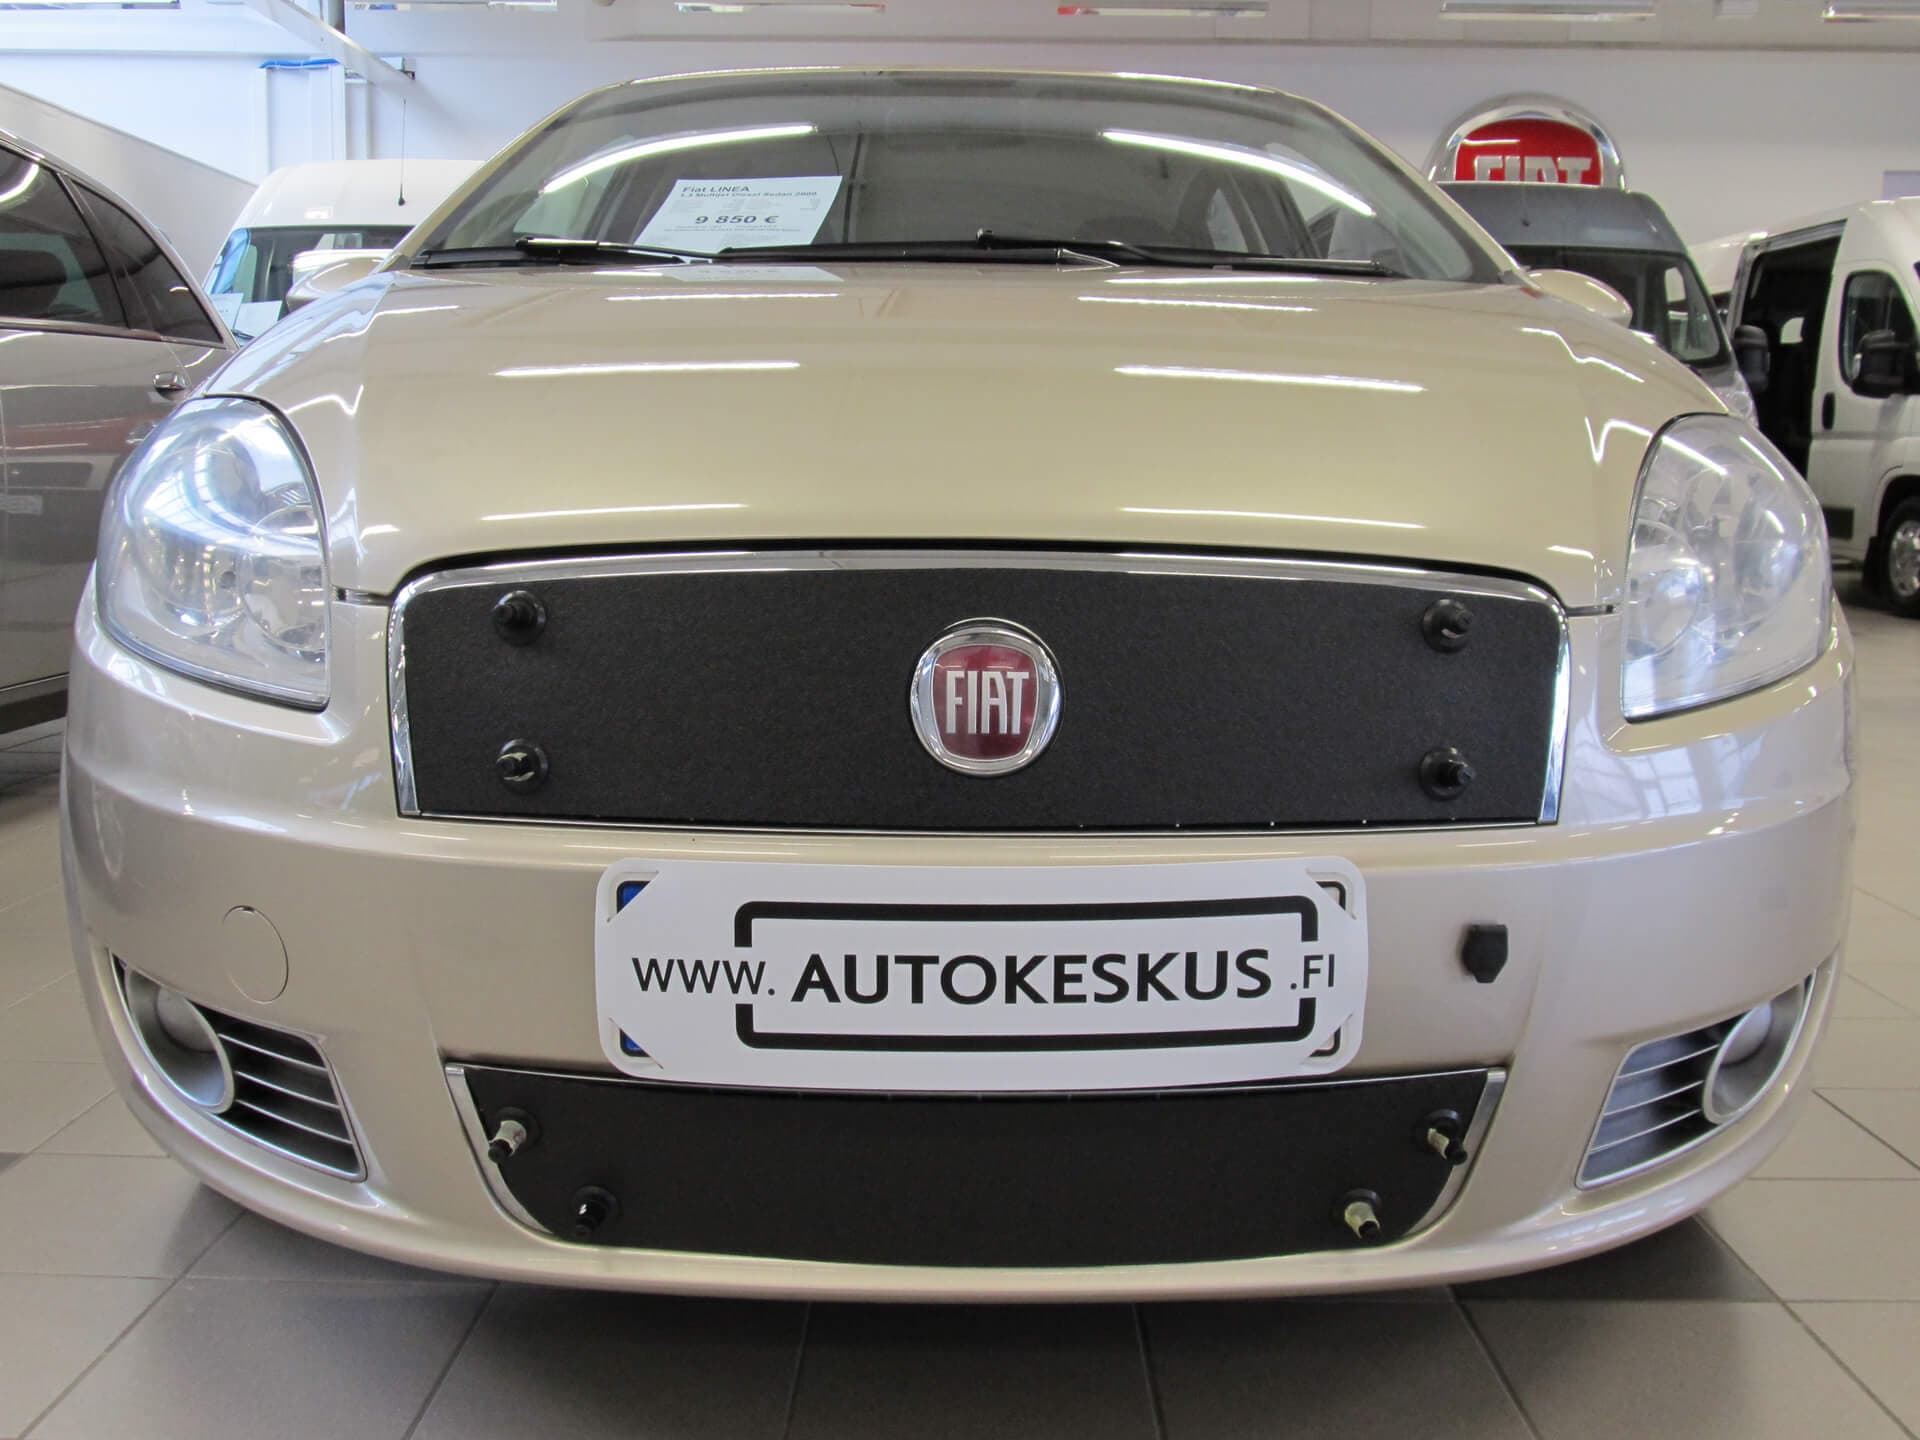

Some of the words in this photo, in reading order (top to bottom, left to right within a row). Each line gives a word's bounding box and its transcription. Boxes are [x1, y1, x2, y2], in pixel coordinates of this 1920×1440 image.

[710, 185, 750, 193] LINEA
[695, 215, 709, 224] 9
[715, 215, 757, 224] 850
[764, 215, 780, 224] €
[946, 670, 1029, 735] FIAT
